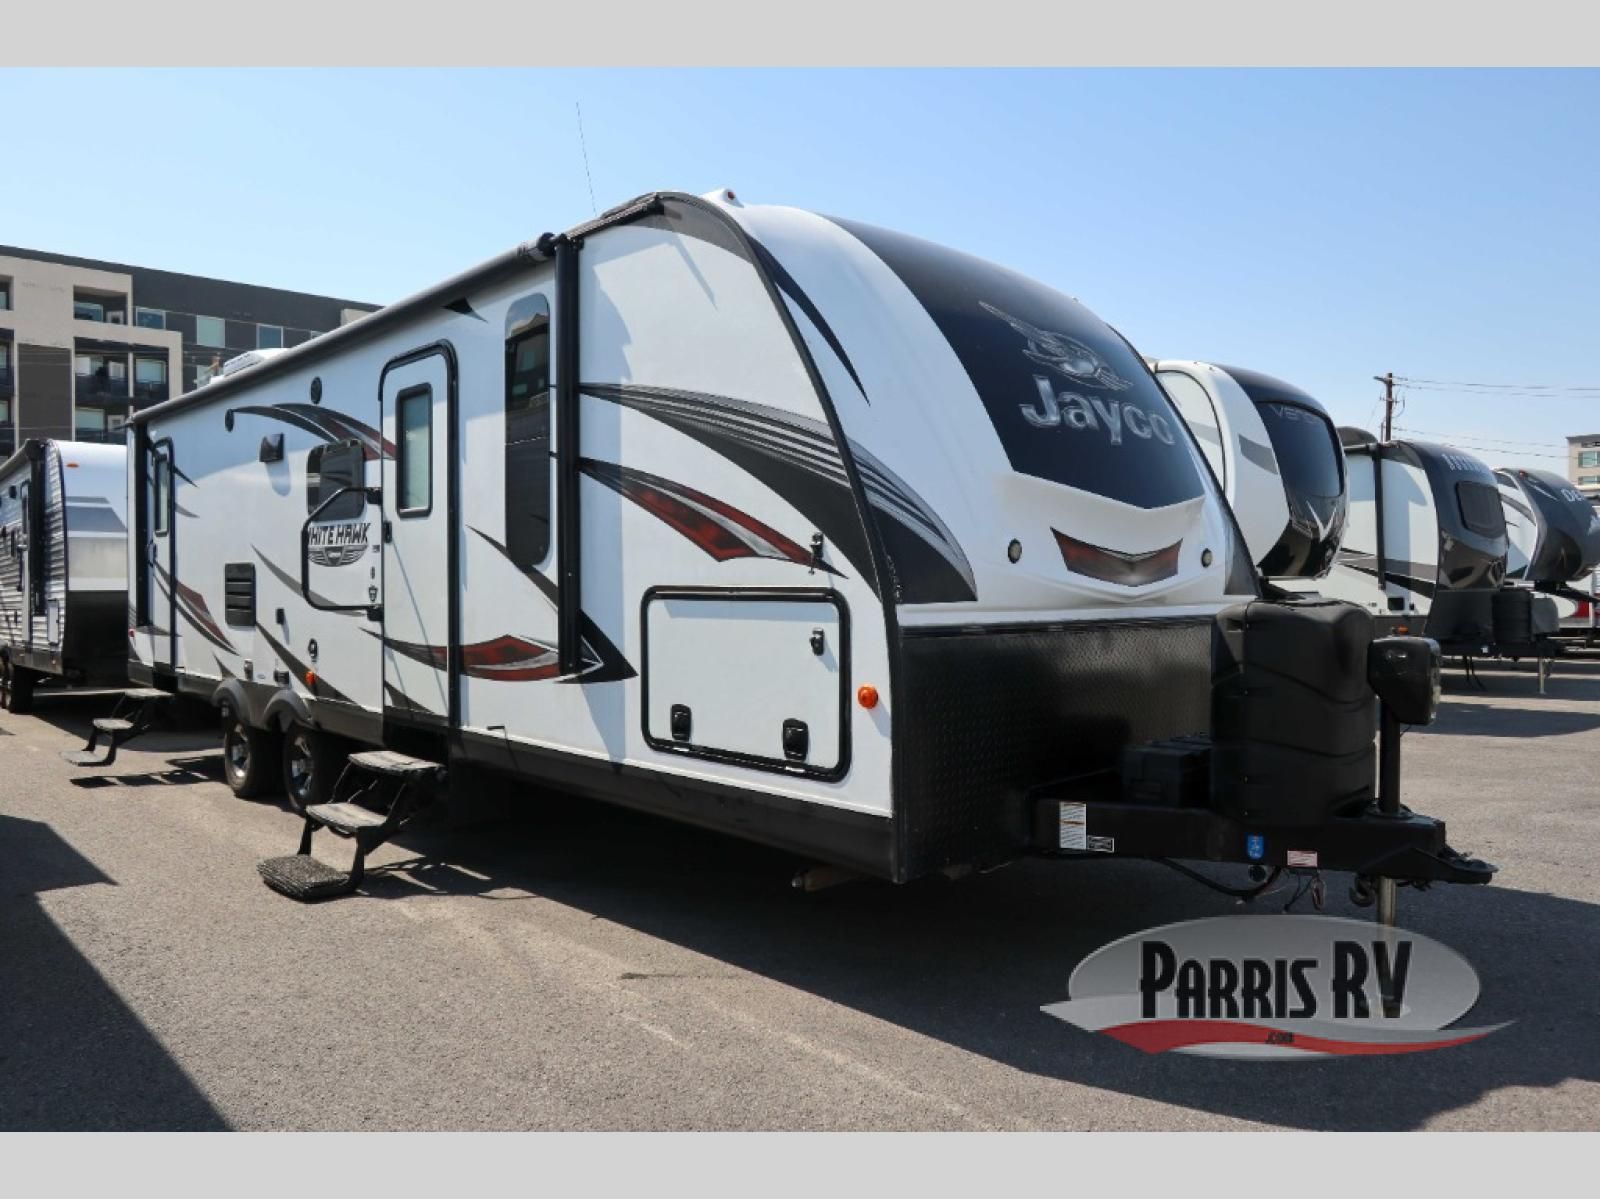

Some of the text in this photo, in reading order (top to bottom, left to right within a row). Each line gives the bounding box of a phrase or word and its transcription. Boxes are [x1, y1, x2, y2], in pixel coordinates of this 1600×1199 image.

[1018, 374, 1176, 445] Jayco
[308, 522, 371, 546] HITE HAWK
